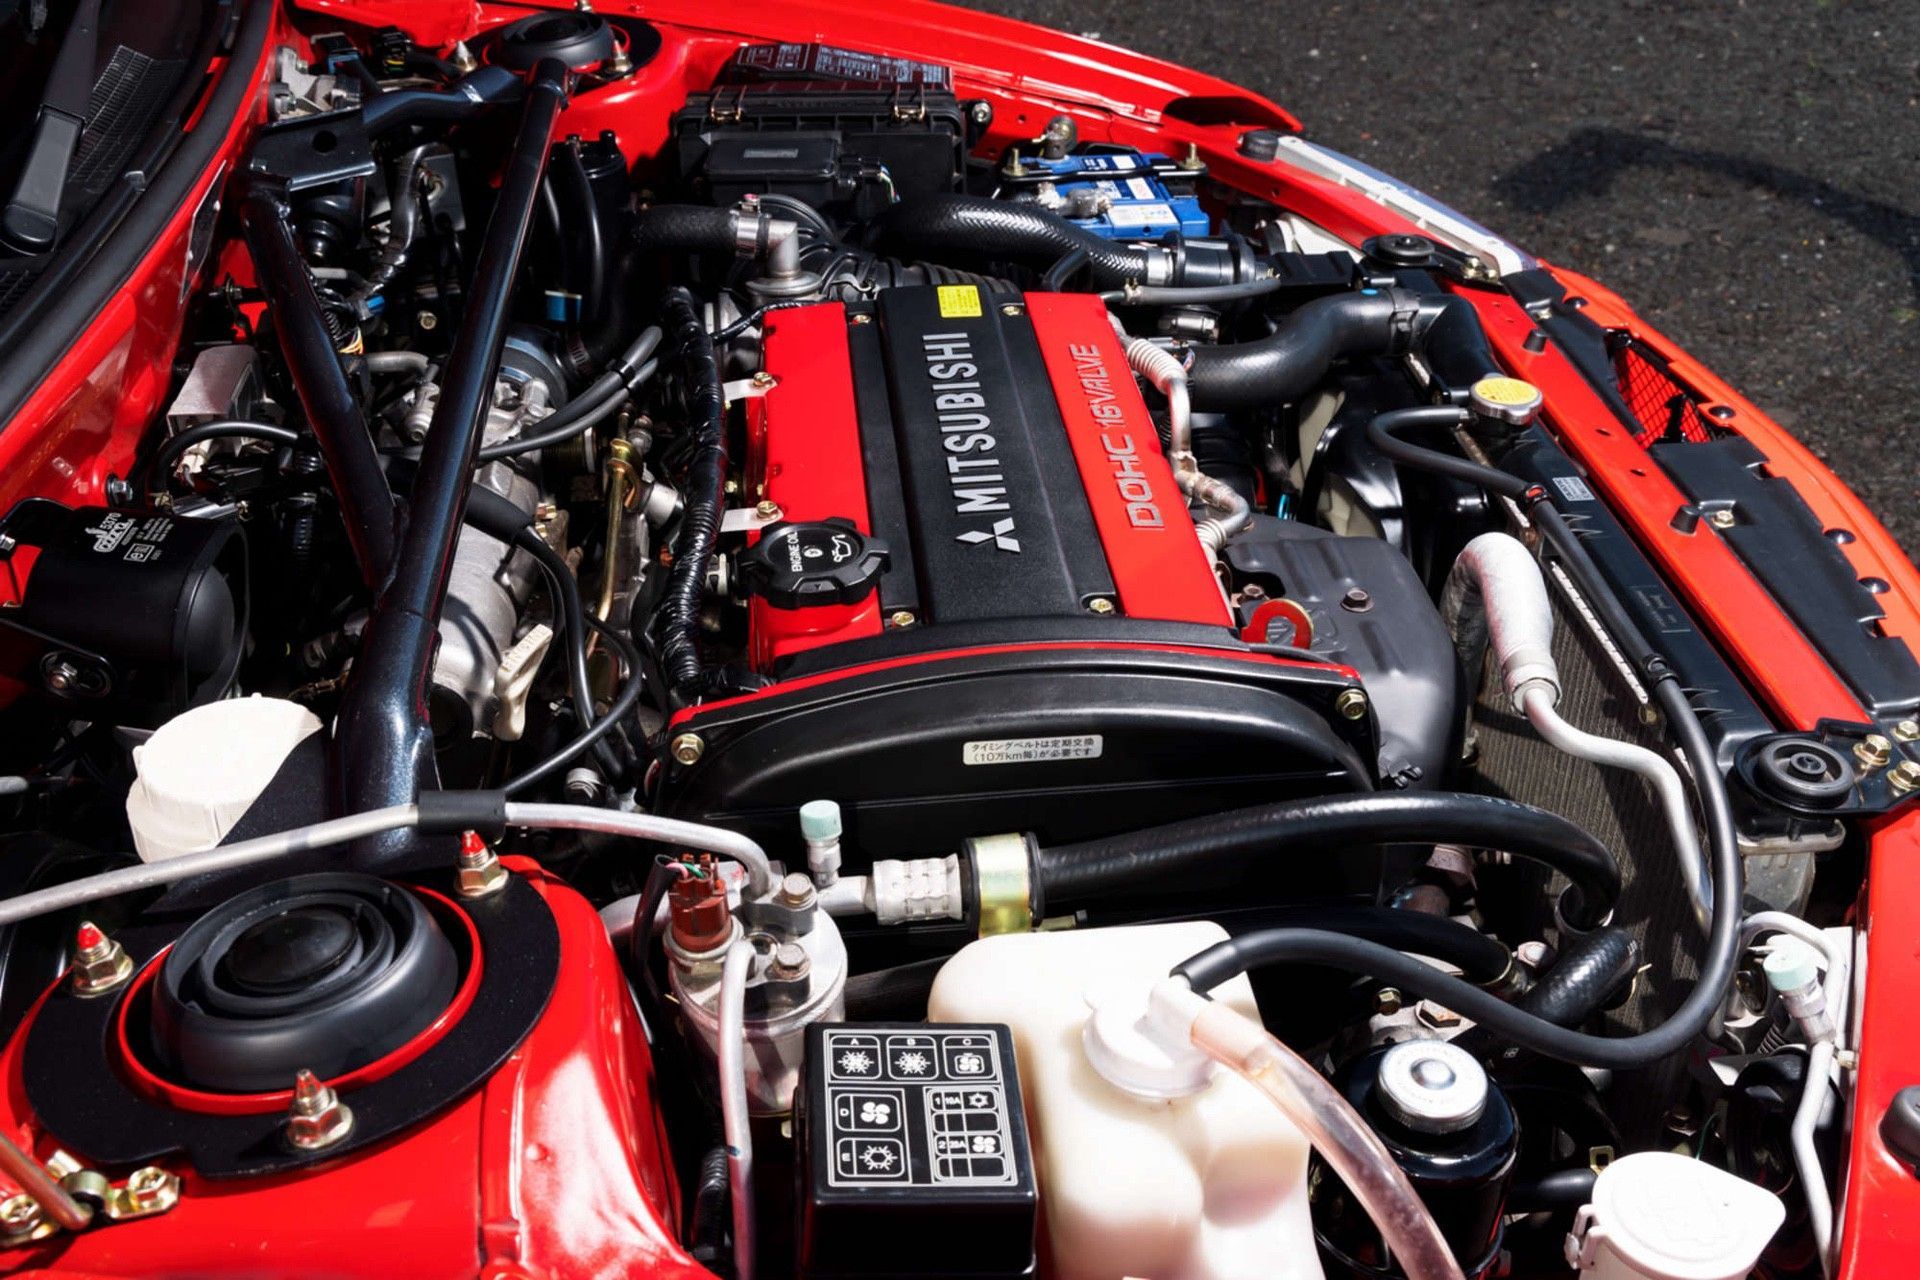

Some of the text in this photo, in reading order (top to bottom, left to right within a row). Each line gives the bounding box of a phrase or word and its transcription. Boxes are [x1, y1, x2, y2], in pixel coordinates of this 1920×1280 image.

[923, 332, 1011, 514] MITSUBISHI
[1101, 434, 1165, 531] DOHC
[99, 512, 122, 530] 5370
[787, 531, 803, 573] ENGINE OIL
[849, 1038, 860, 1046] A
[962, 1038, 972, 1046] C
[839, 1108, 850, 1117] D
[938, 1140, 946, 1149] 2
